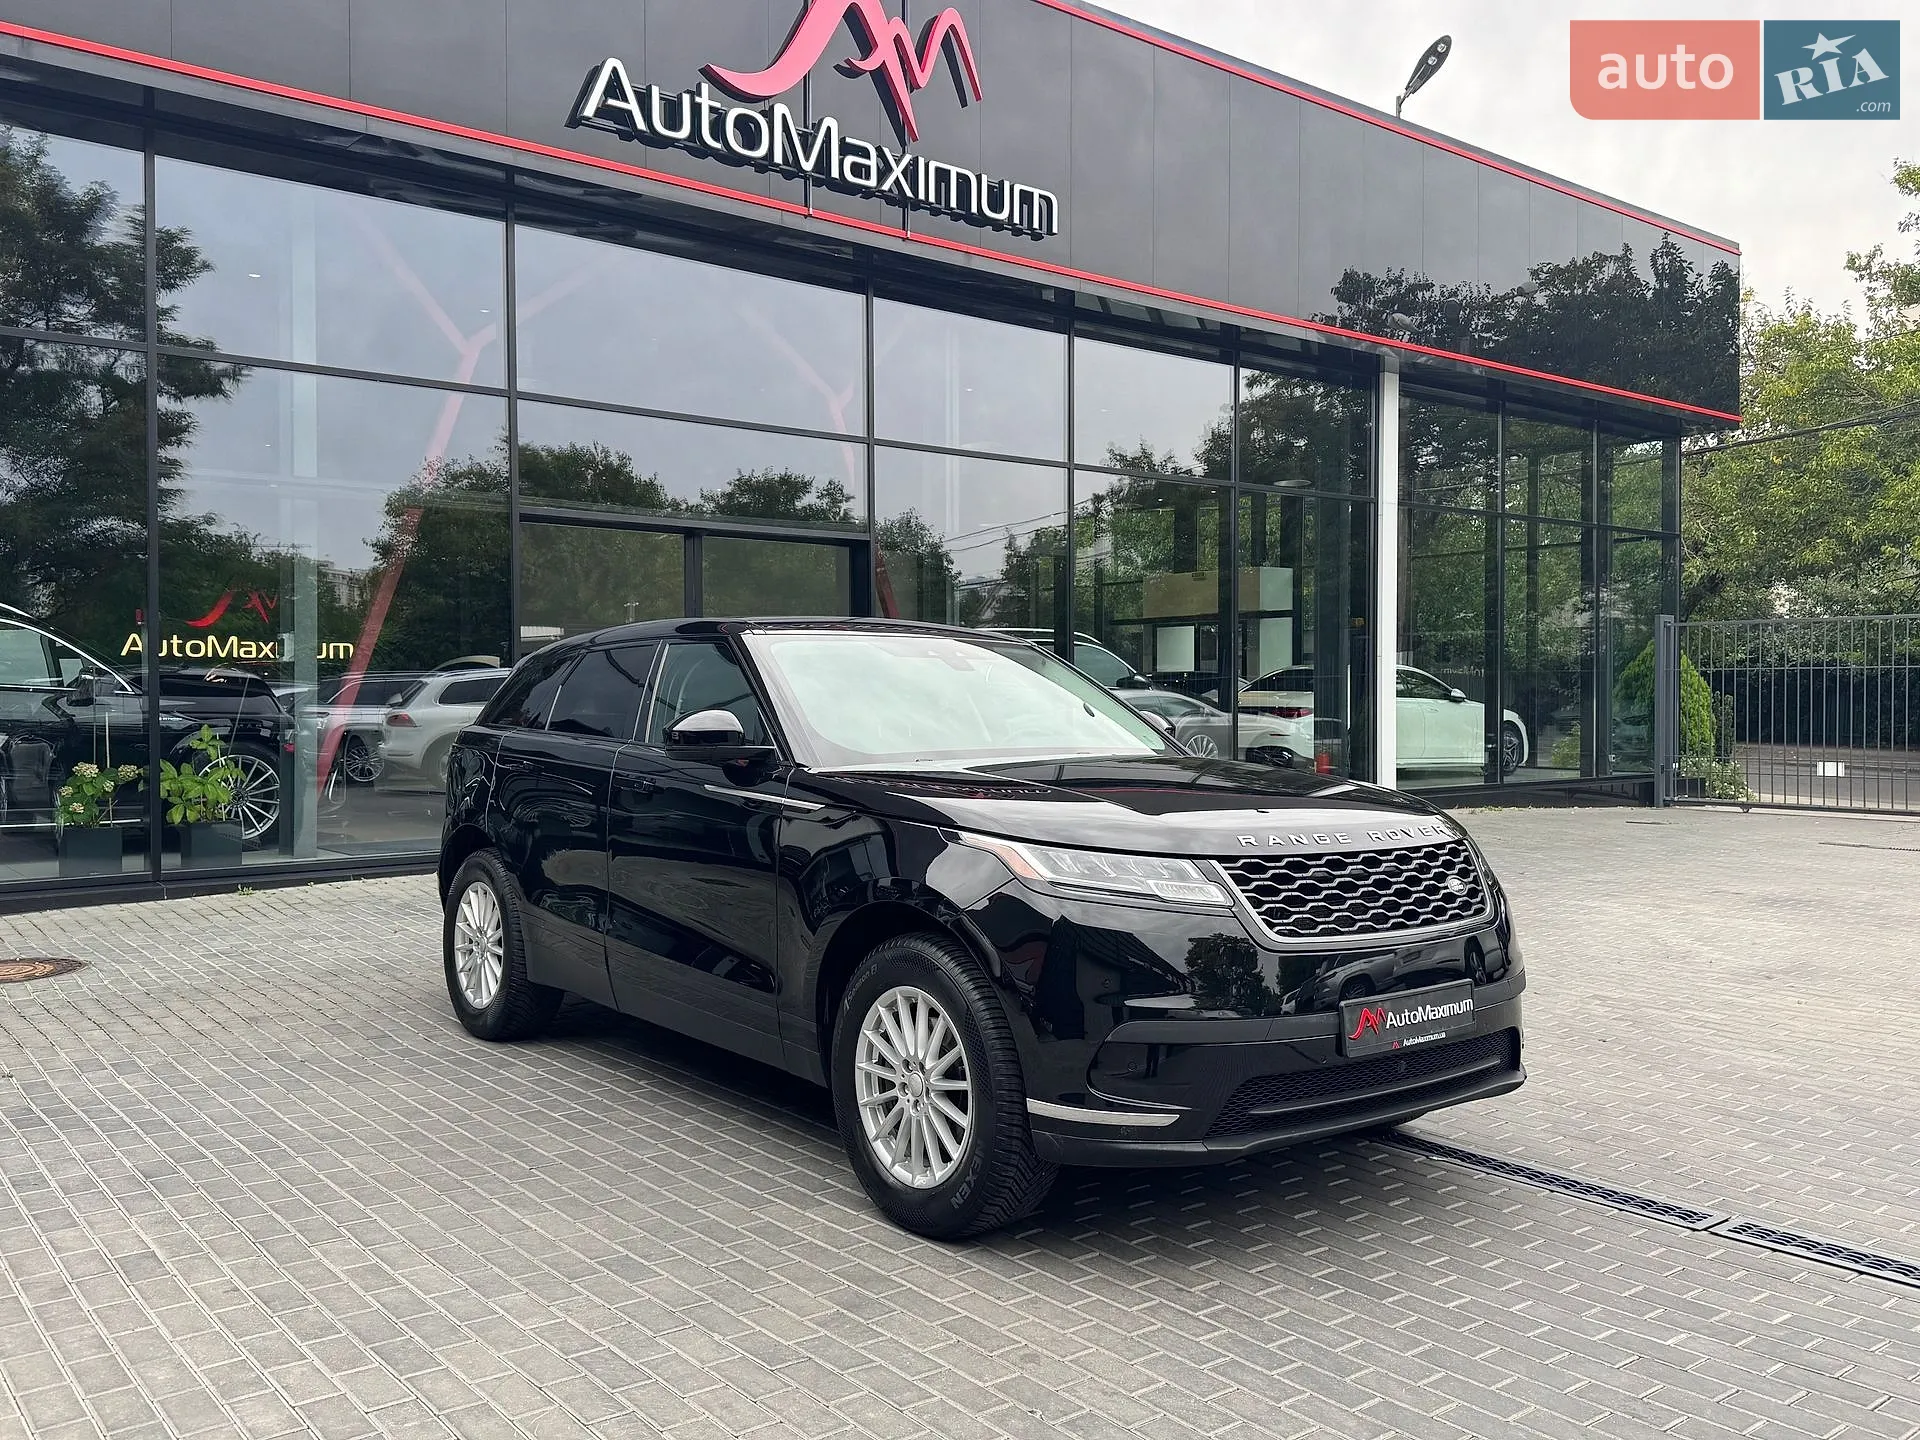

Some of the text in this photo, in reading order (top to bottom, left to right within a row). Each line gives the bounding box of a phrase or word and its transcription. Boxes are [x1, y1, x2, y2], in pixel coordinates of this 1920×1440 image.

[579, 56, 1060, 236] AutoMaximum
[1236, 824, 1451, 848] RANGE ROVER
[1385, 998, 1474, 1029] AutoMaximum
